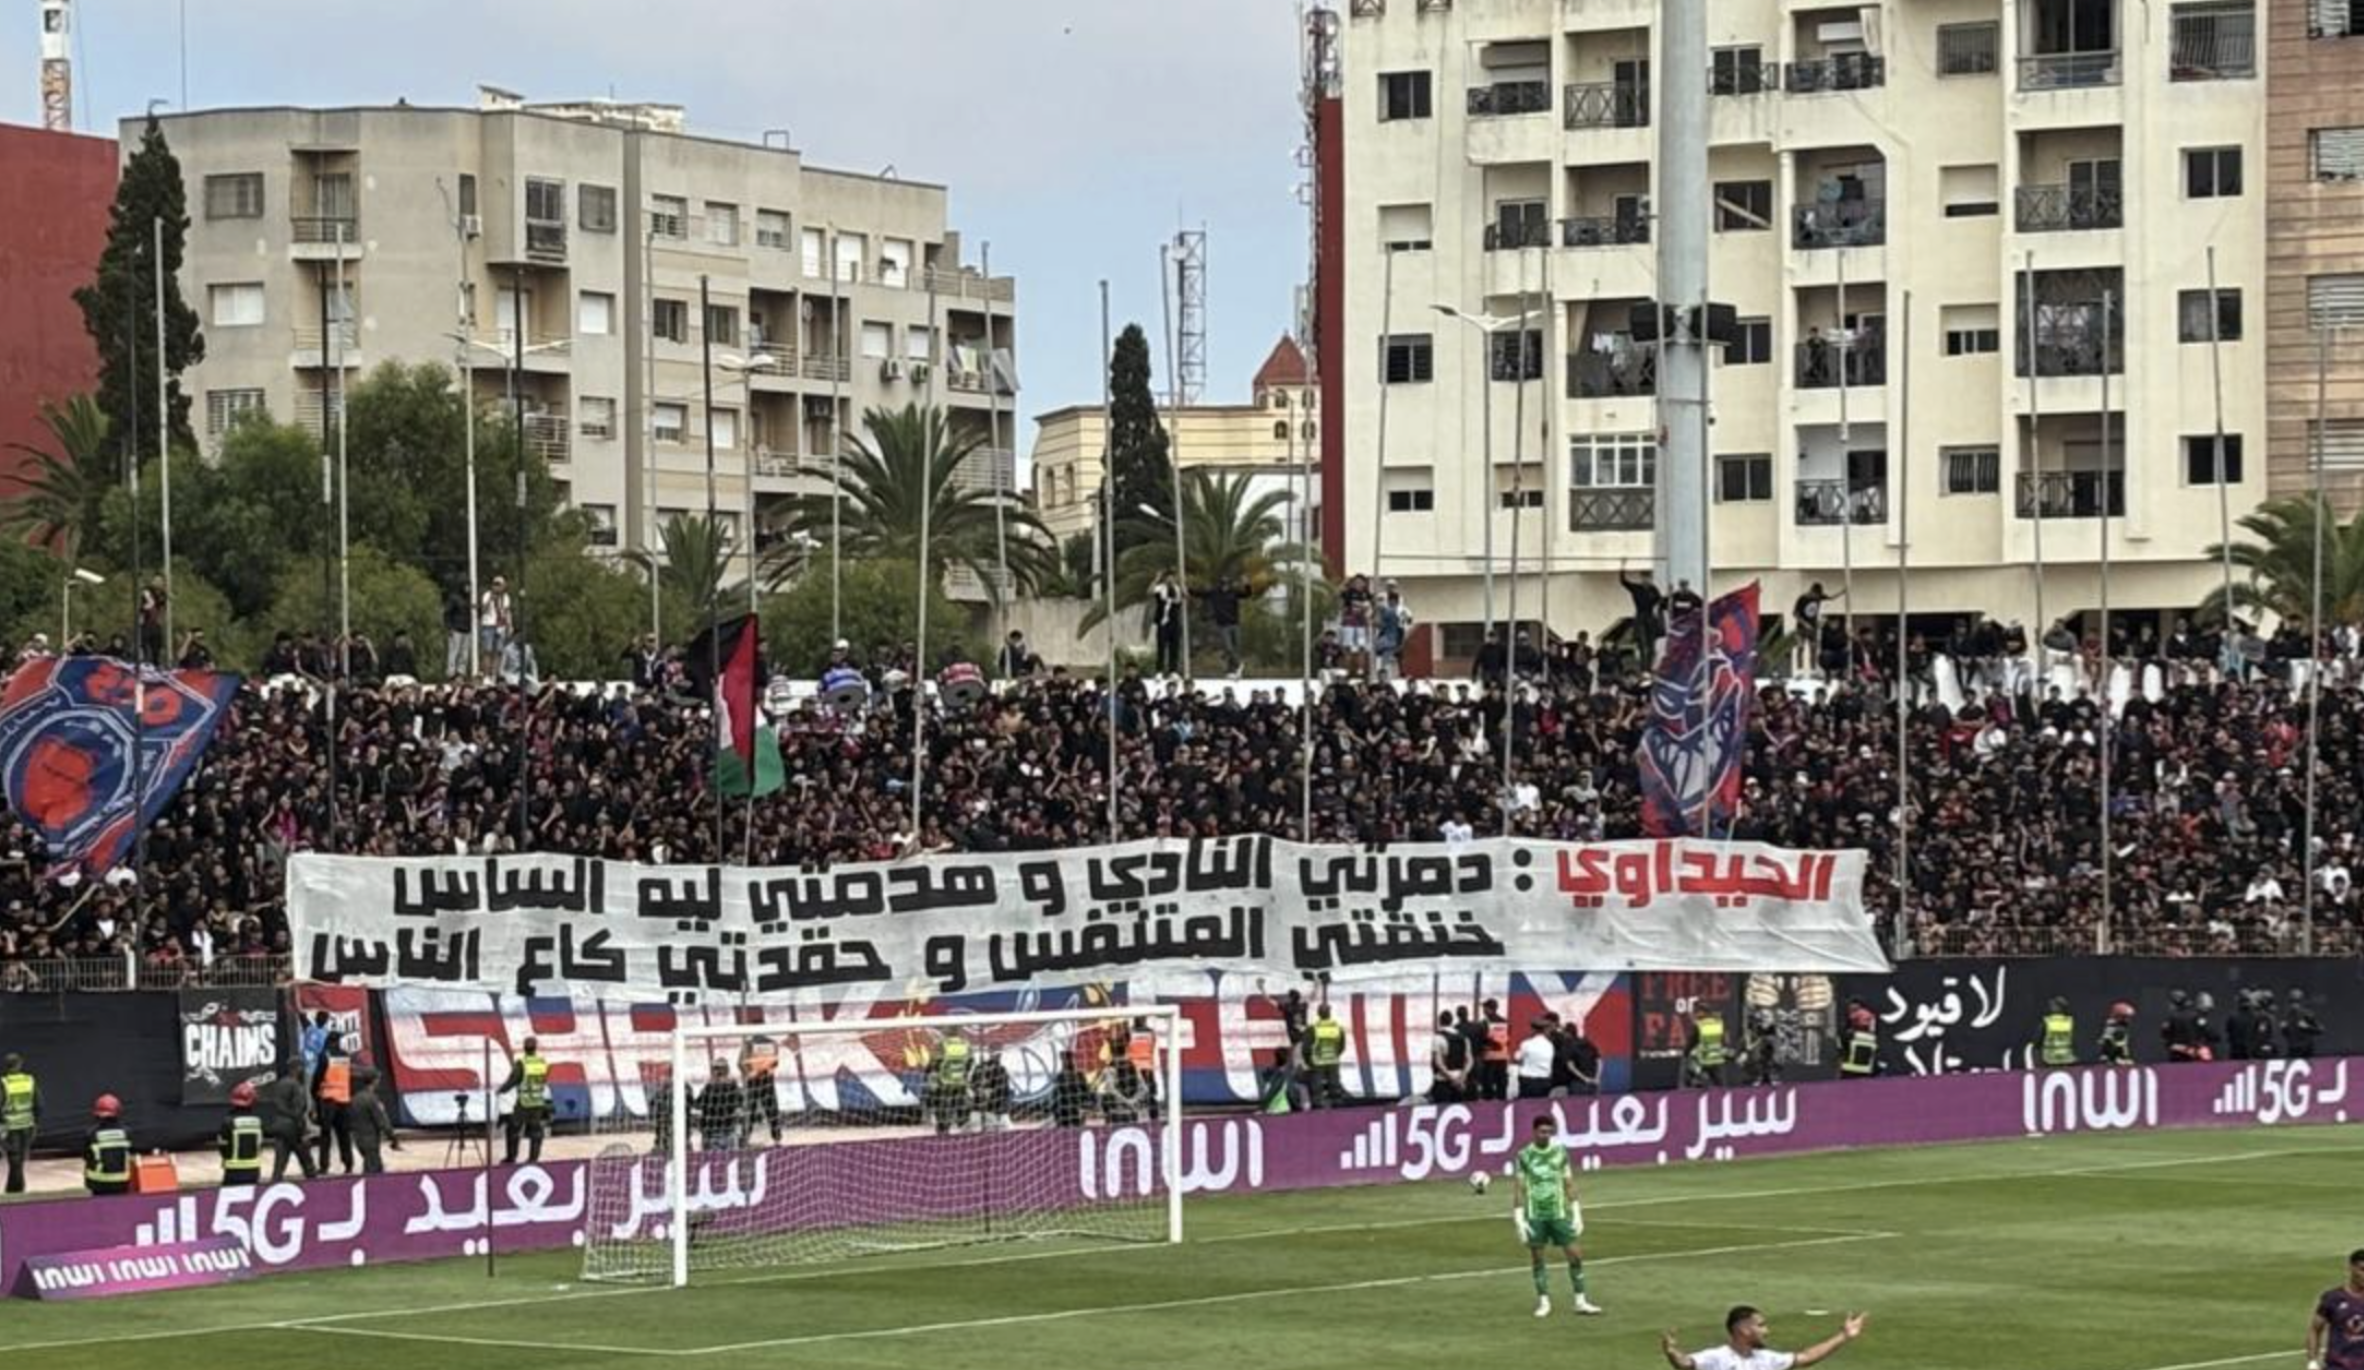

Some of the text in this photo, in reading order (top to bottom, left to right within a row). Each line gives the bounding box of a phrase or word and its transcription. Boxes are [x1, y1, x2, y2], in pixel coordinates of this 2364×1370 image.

[394, 836, 1836, 933] الحيداوي : دمرتي النادي و هدمتي ليه الساس
[311, 902, 1505, 1004] خنقتي المتنفس و حقدتي كاع الناس
[1675, 996, 1699, 1013] or
[1880, 965, 2006, 1041] لا قيود
[185, 1022, 277, 1069] CHAINS
[1685, 1087, 1798, 1161] سير
[2023, 1066, 2158, 1132] inwi
[2258, 1058, 2311, 1125] 5G
[1401, 1103, 1473, 1181] 5G
[1550, 1094, 1669, 1171] بعيد
[211, 1182, 305, 1264] 5G
[405, 1164, 586, 1257] بعيد
[33, 1246, 251, 1290] inwi inwi inwi
